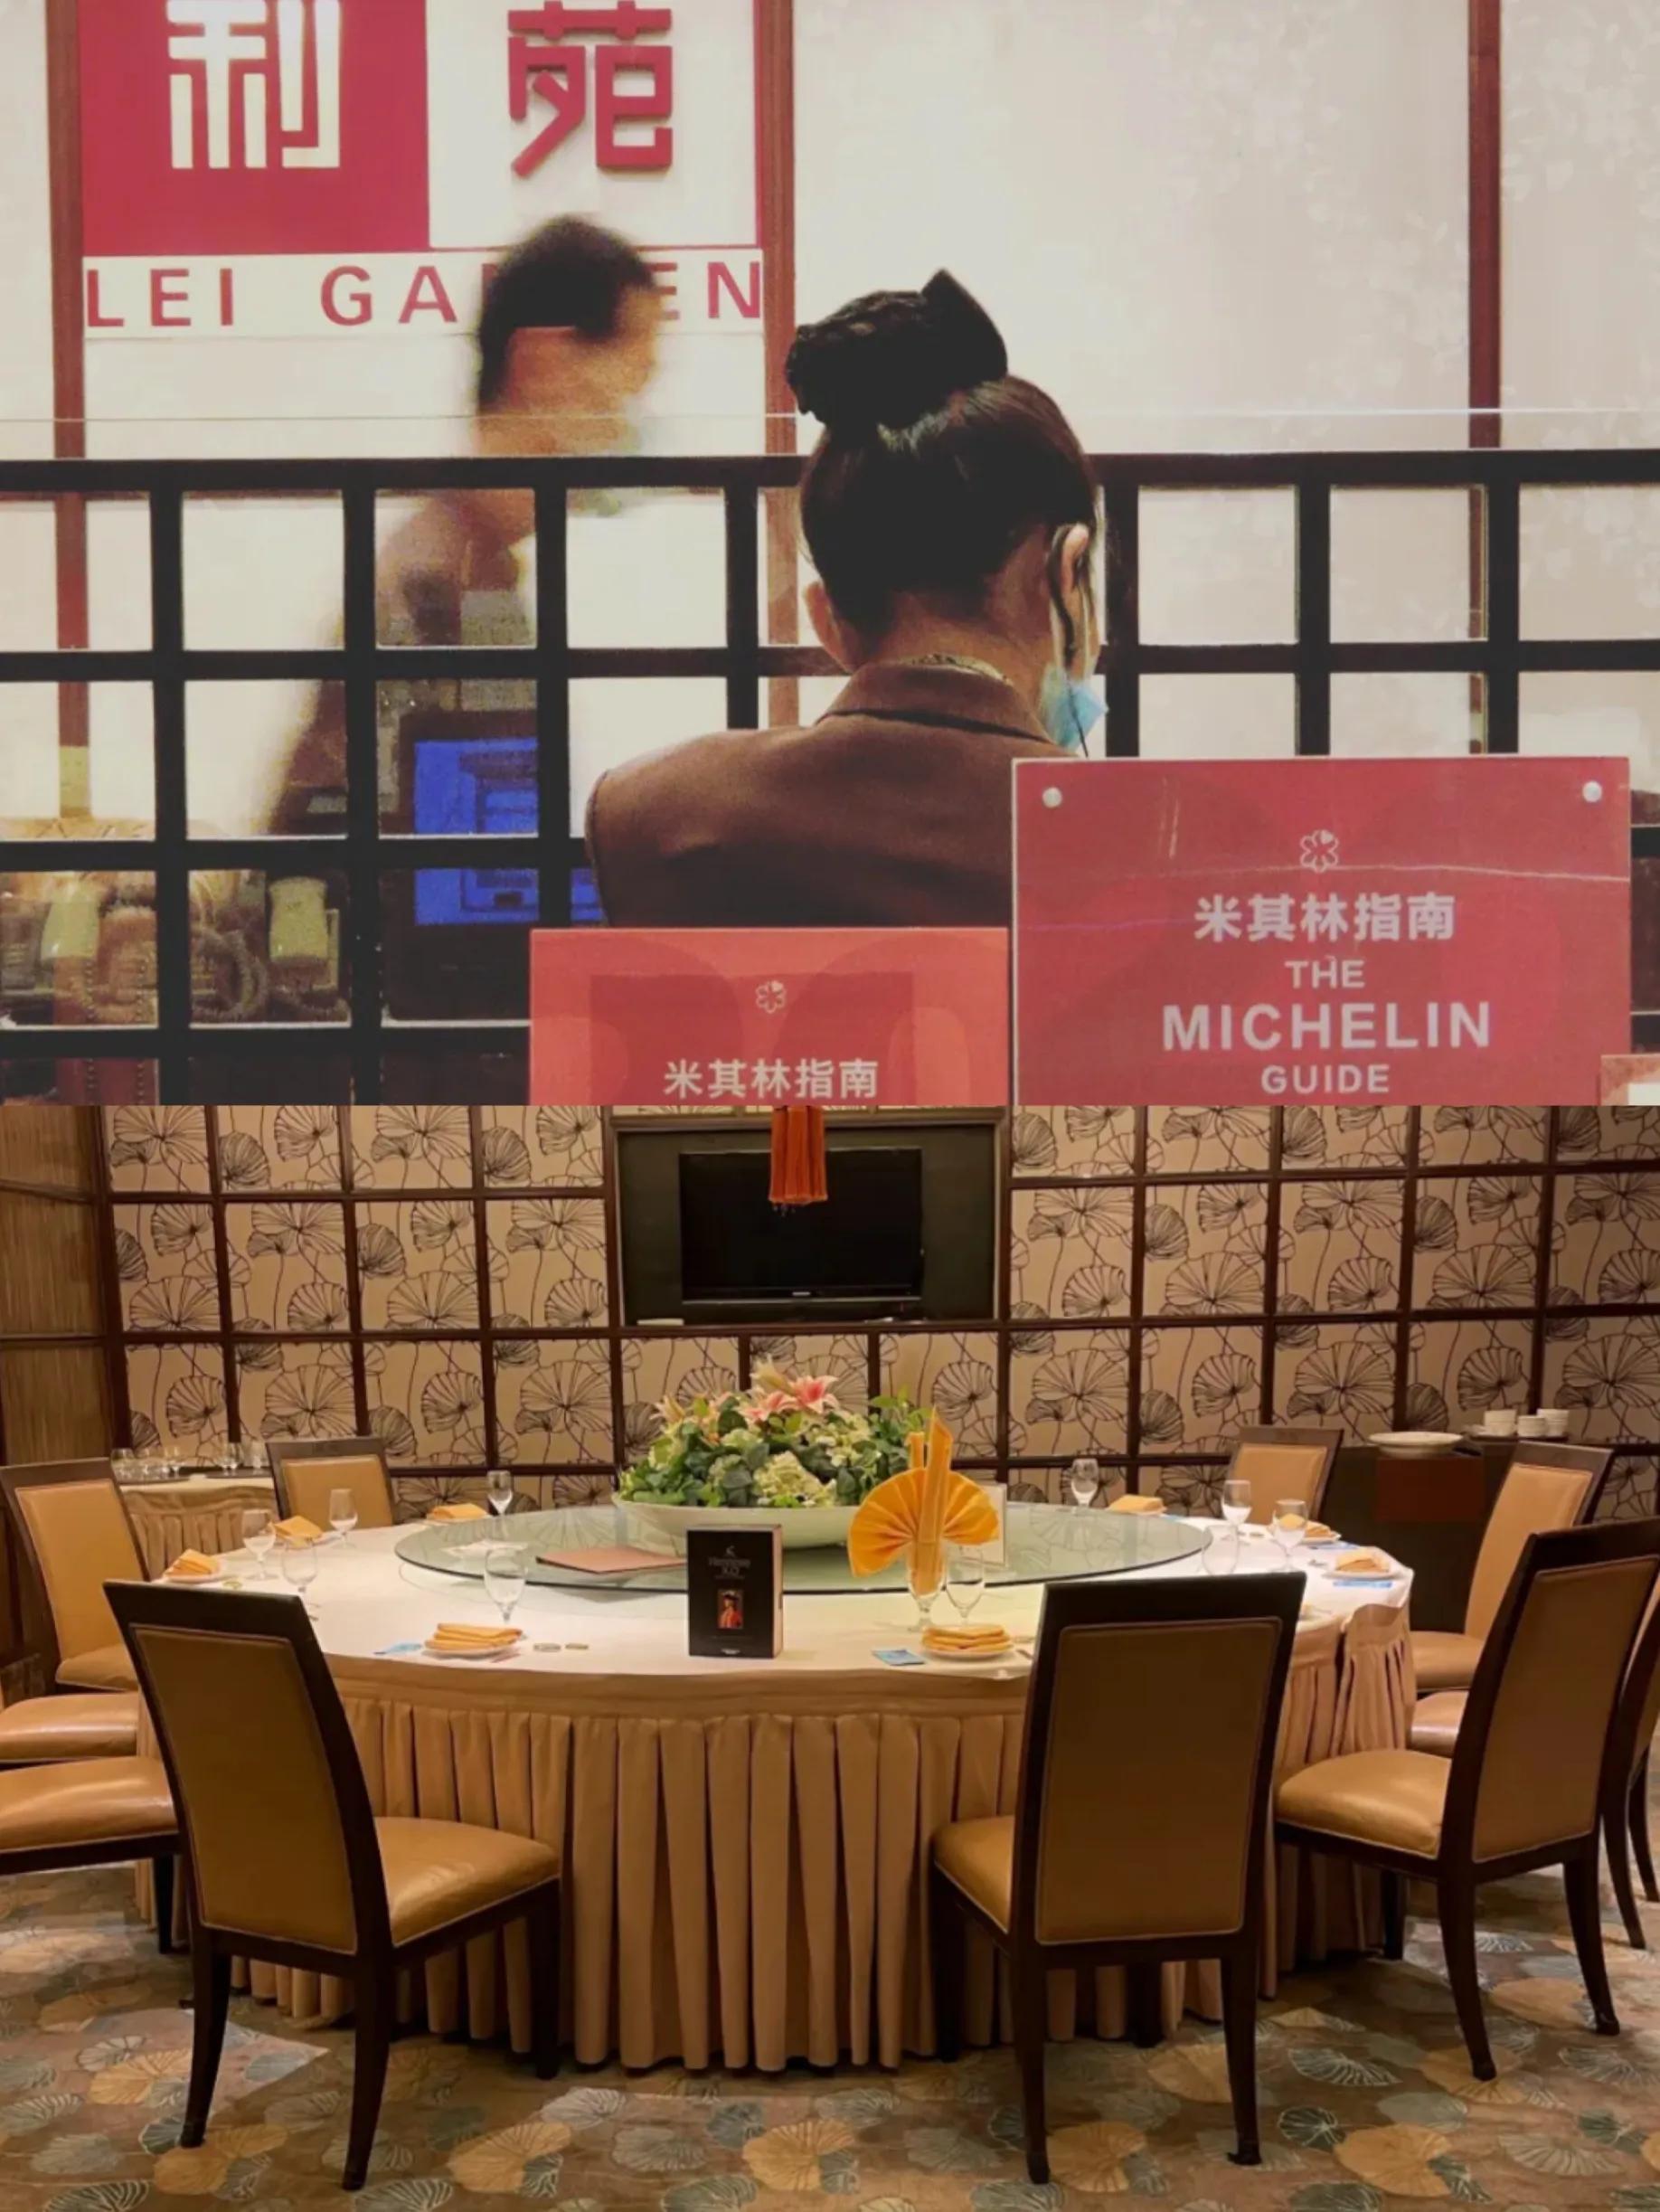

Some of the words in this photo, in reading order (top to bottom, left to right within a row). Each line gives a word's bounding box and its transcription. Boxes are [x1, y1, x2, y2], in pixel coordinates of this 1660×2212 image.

[87, 268, 234, 327] LEI
[1193, 892, 1457, 942] 米其林指南
[1286, 959, 1366, 988] THE
[1163, 1001, 1491, 1051] MICHELIN
[663, 1057, 880, 1101] 米其林指南
[1260, 1063, 1391, 1094] GUIDE
